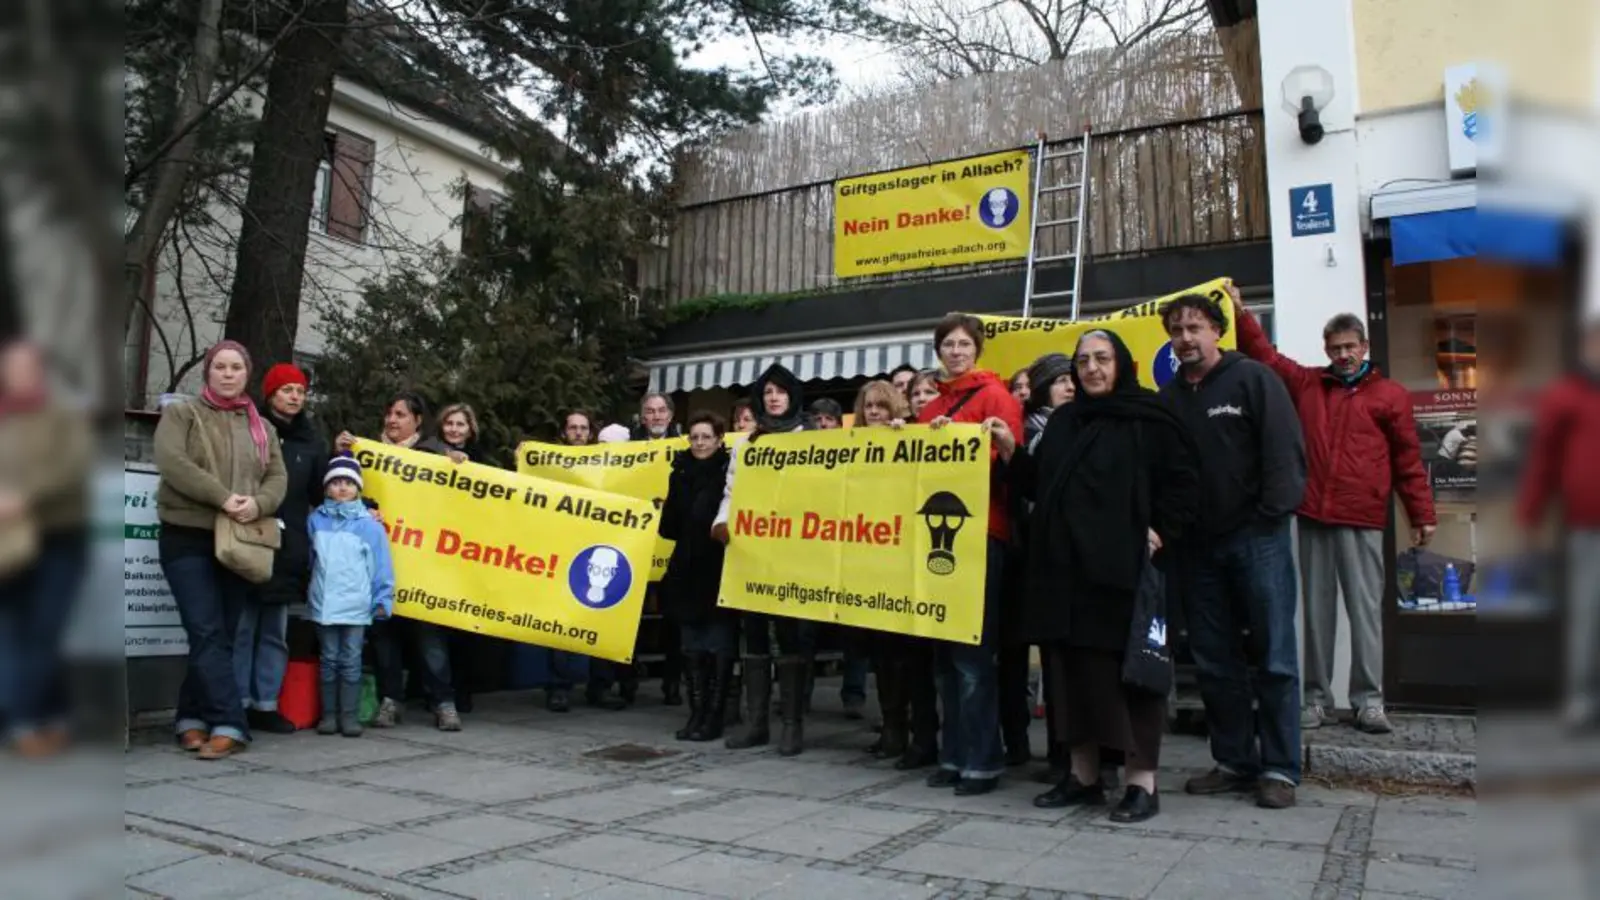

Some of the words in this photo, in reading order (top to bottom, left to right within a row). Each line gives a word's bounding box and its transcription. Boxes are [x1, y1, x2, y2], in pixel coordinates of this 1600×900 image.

[840, 174, 936, 197] Giftgaslager
[942, 169, 956, 183] in
[960, 158, 1023, 180] Allach?
[1302, 190, 1318, 212] 4
[844, 218, 889, 236] Nein
[897, 204, 971, 229] Danke!
[855, 241, 1006, 267] www.giftgasfreies-allach.org
[526, 449, 658, 469] Giftgaslager
[743, 445, 859, 470] Giftgaslager
[865, 441, 885, 463] in
[893, 437, 981, 463] Allach?
[358, 450, 516, 500] Giftgaslager
[524, 487, 547, 509] in
[555, 495, 653, 531] Allach?
[734, 510, 792, 539] Nein
[801, 512, 902, 546] Danke!
[436, 528, 559, 580] Danke!
[393, 587, 599, 645] .giftgasfreies-allach.org
[745, 581, 946, 622] www.giftgasfreies-allach.org
